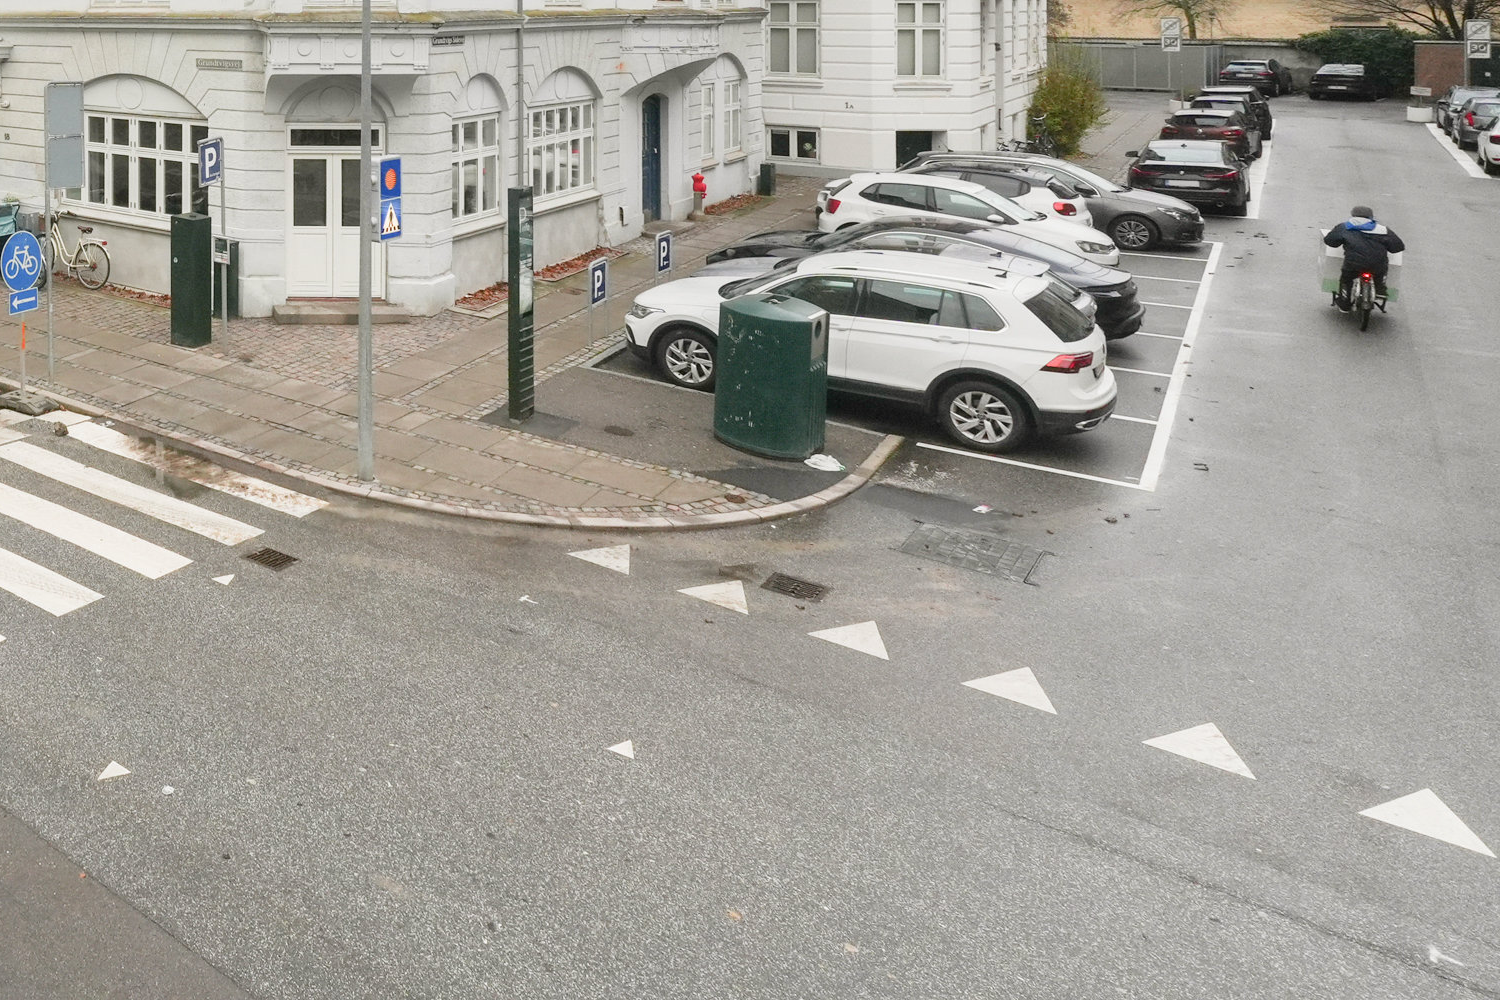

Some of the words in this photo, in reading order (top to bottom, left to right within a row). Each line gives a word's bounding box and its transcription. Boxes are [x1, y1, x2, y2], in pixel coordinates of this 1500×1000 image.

[205, 147, 217, 178] P
[661, 241, 668, 267] P
[594, 269, 603, 298] P
